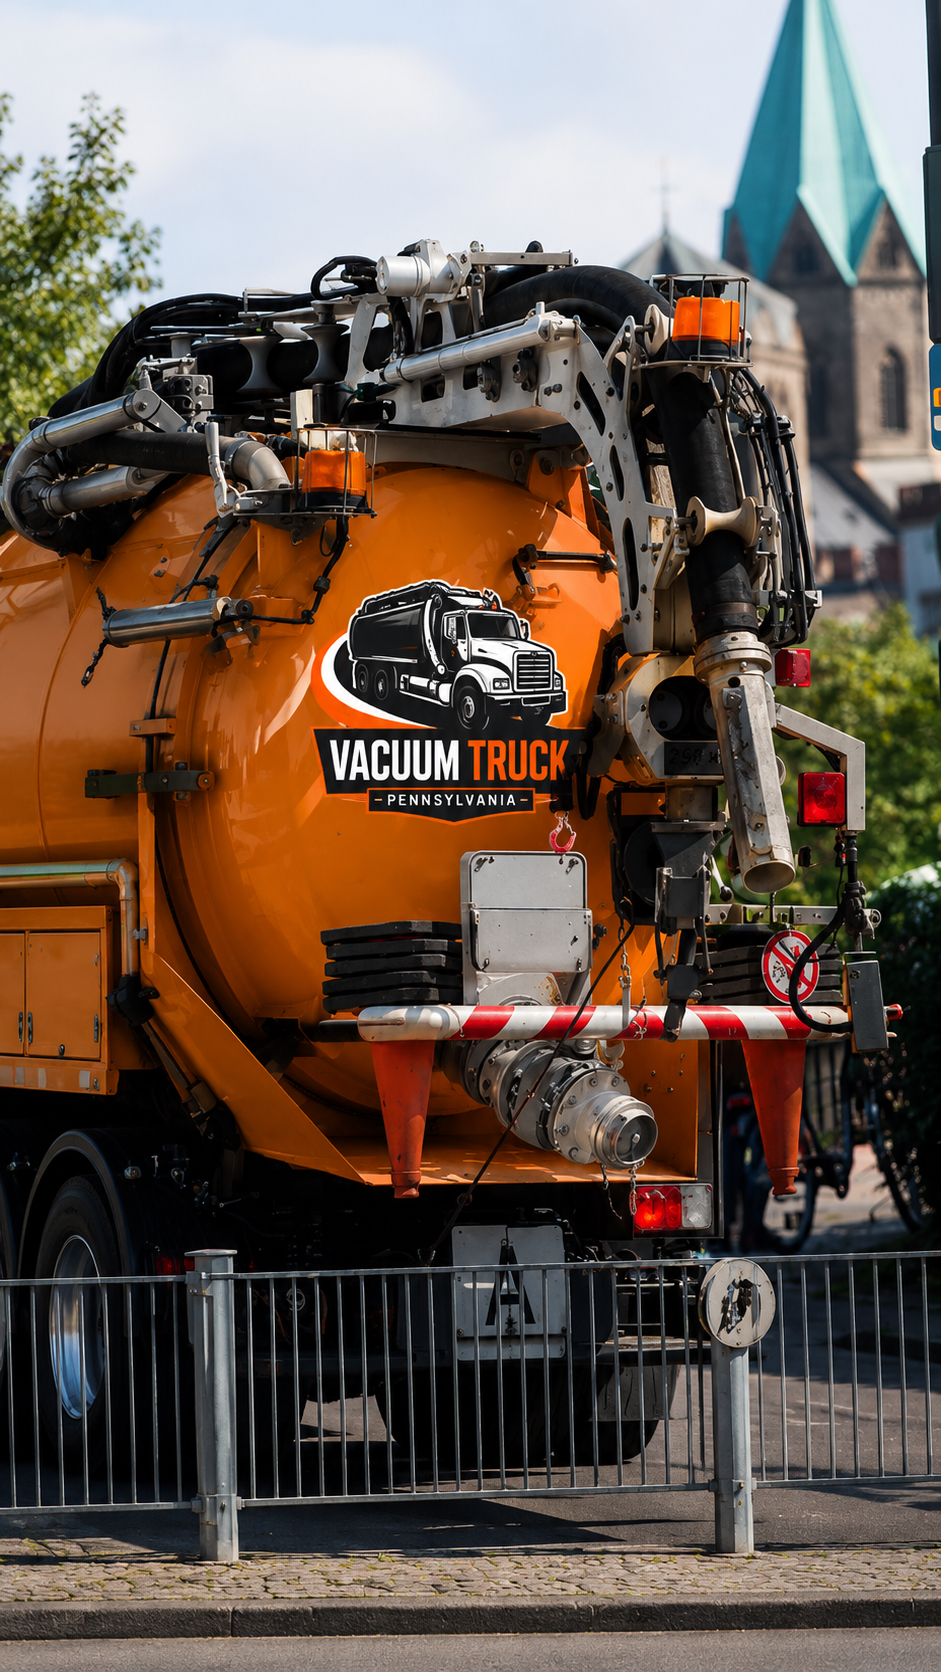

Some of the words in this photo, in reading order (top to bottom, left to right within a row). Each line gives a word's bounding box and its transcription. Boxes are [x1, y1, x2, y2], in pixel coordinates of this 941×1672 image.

[329, 739, 459, 781] VACUUM
[468, 739, 569, 781] TRUCK
[387, 794, 516, 806] PENNSYLVANIA
[485, 1245, 536, 1326] A
